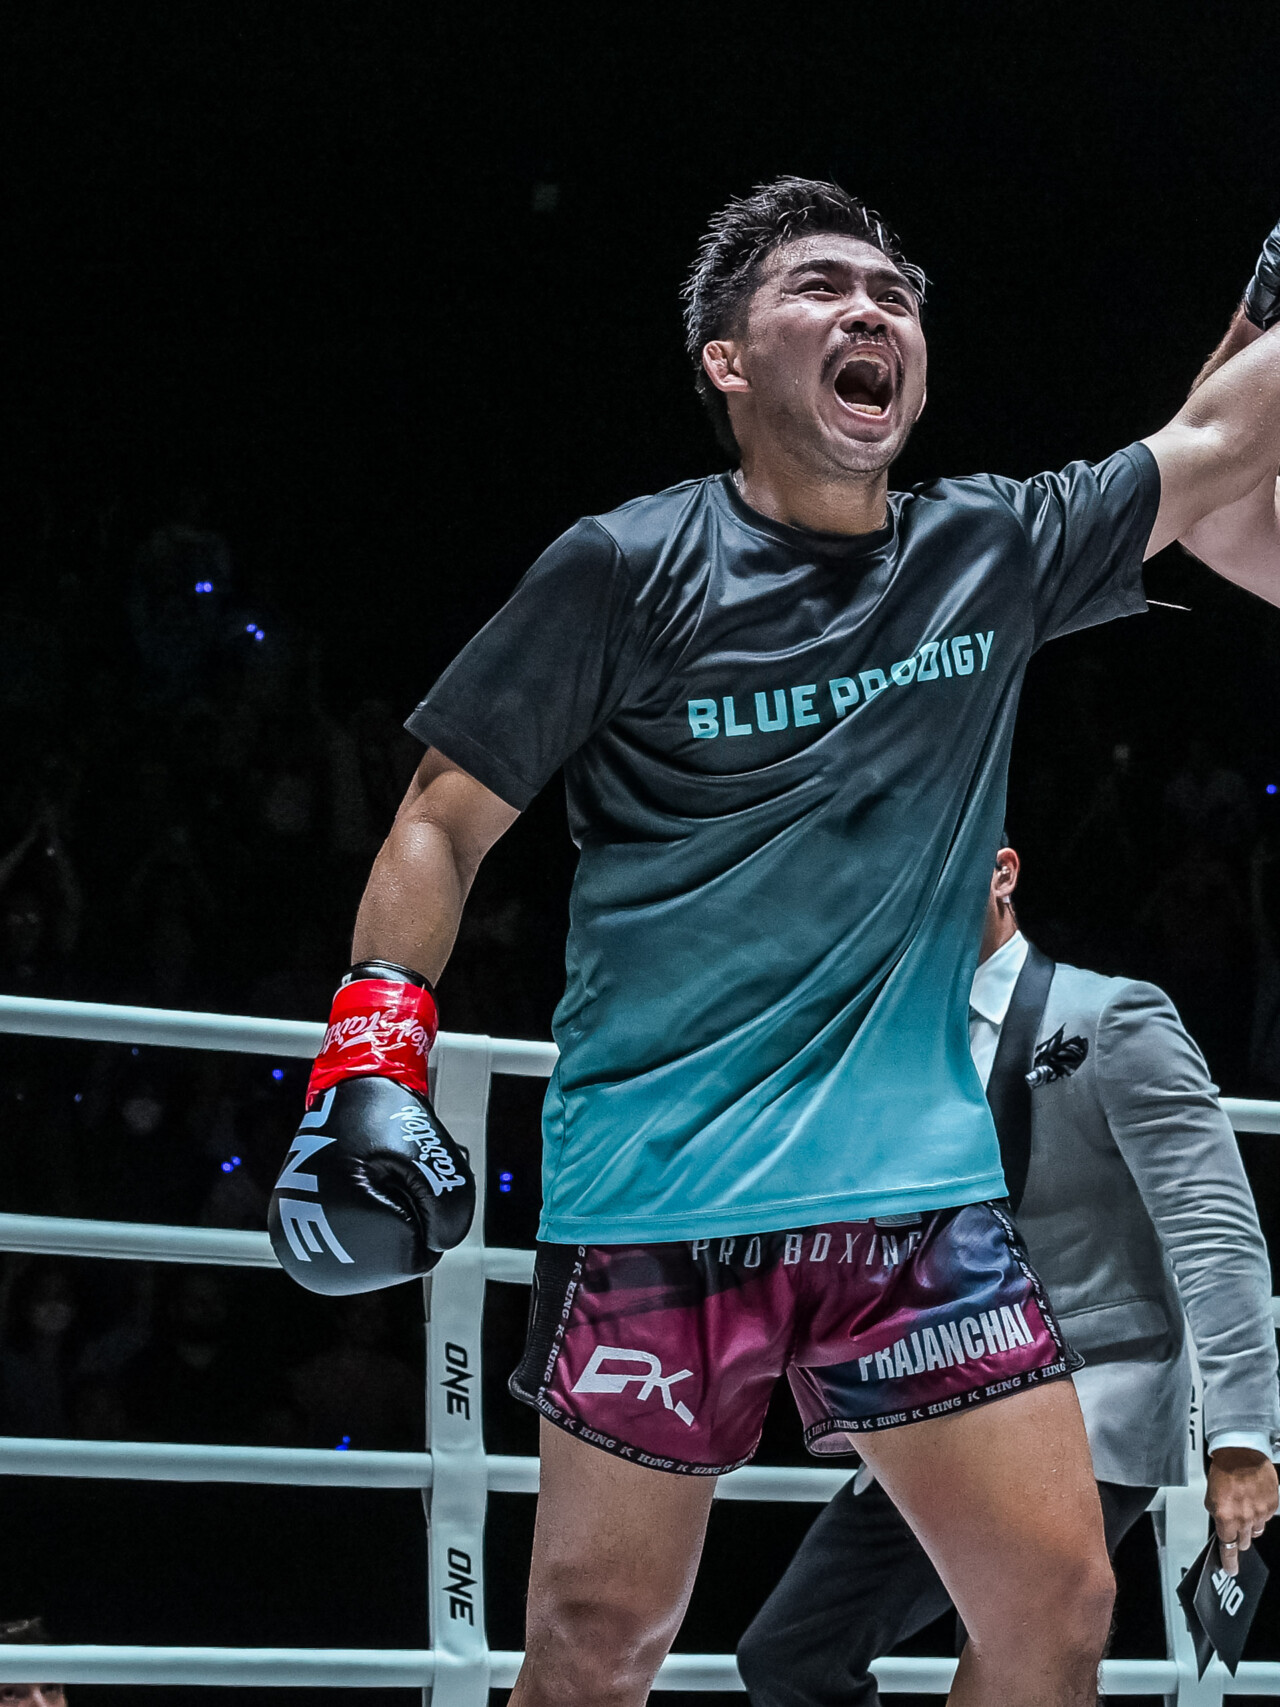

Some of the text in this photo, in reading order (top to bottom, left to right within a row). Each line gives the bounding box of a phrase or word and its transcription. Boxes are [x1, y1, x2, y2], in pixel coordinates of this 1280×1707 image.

[687, 630, 994, 739] BLUE PRODIGY
[389, 1105, 466, 1197] Fairtex
[692, 1236, 762, 1268] PRO
[439, 1341, 475, 1421] ONE
[858, 1302, 1035, 1382] PRAJANCHAI
[876, 1413, 907, 1427] KING
[927, 1397, 962, 1415] KING
[985, 1377, 1022, 1397] KING
[1042, 1363, 1066, 1378] KING
[578, 1426, 616, 1449] KING
[637, 1453, 674, 1469] KING
[441, 1547, 478, 1627] ONE
